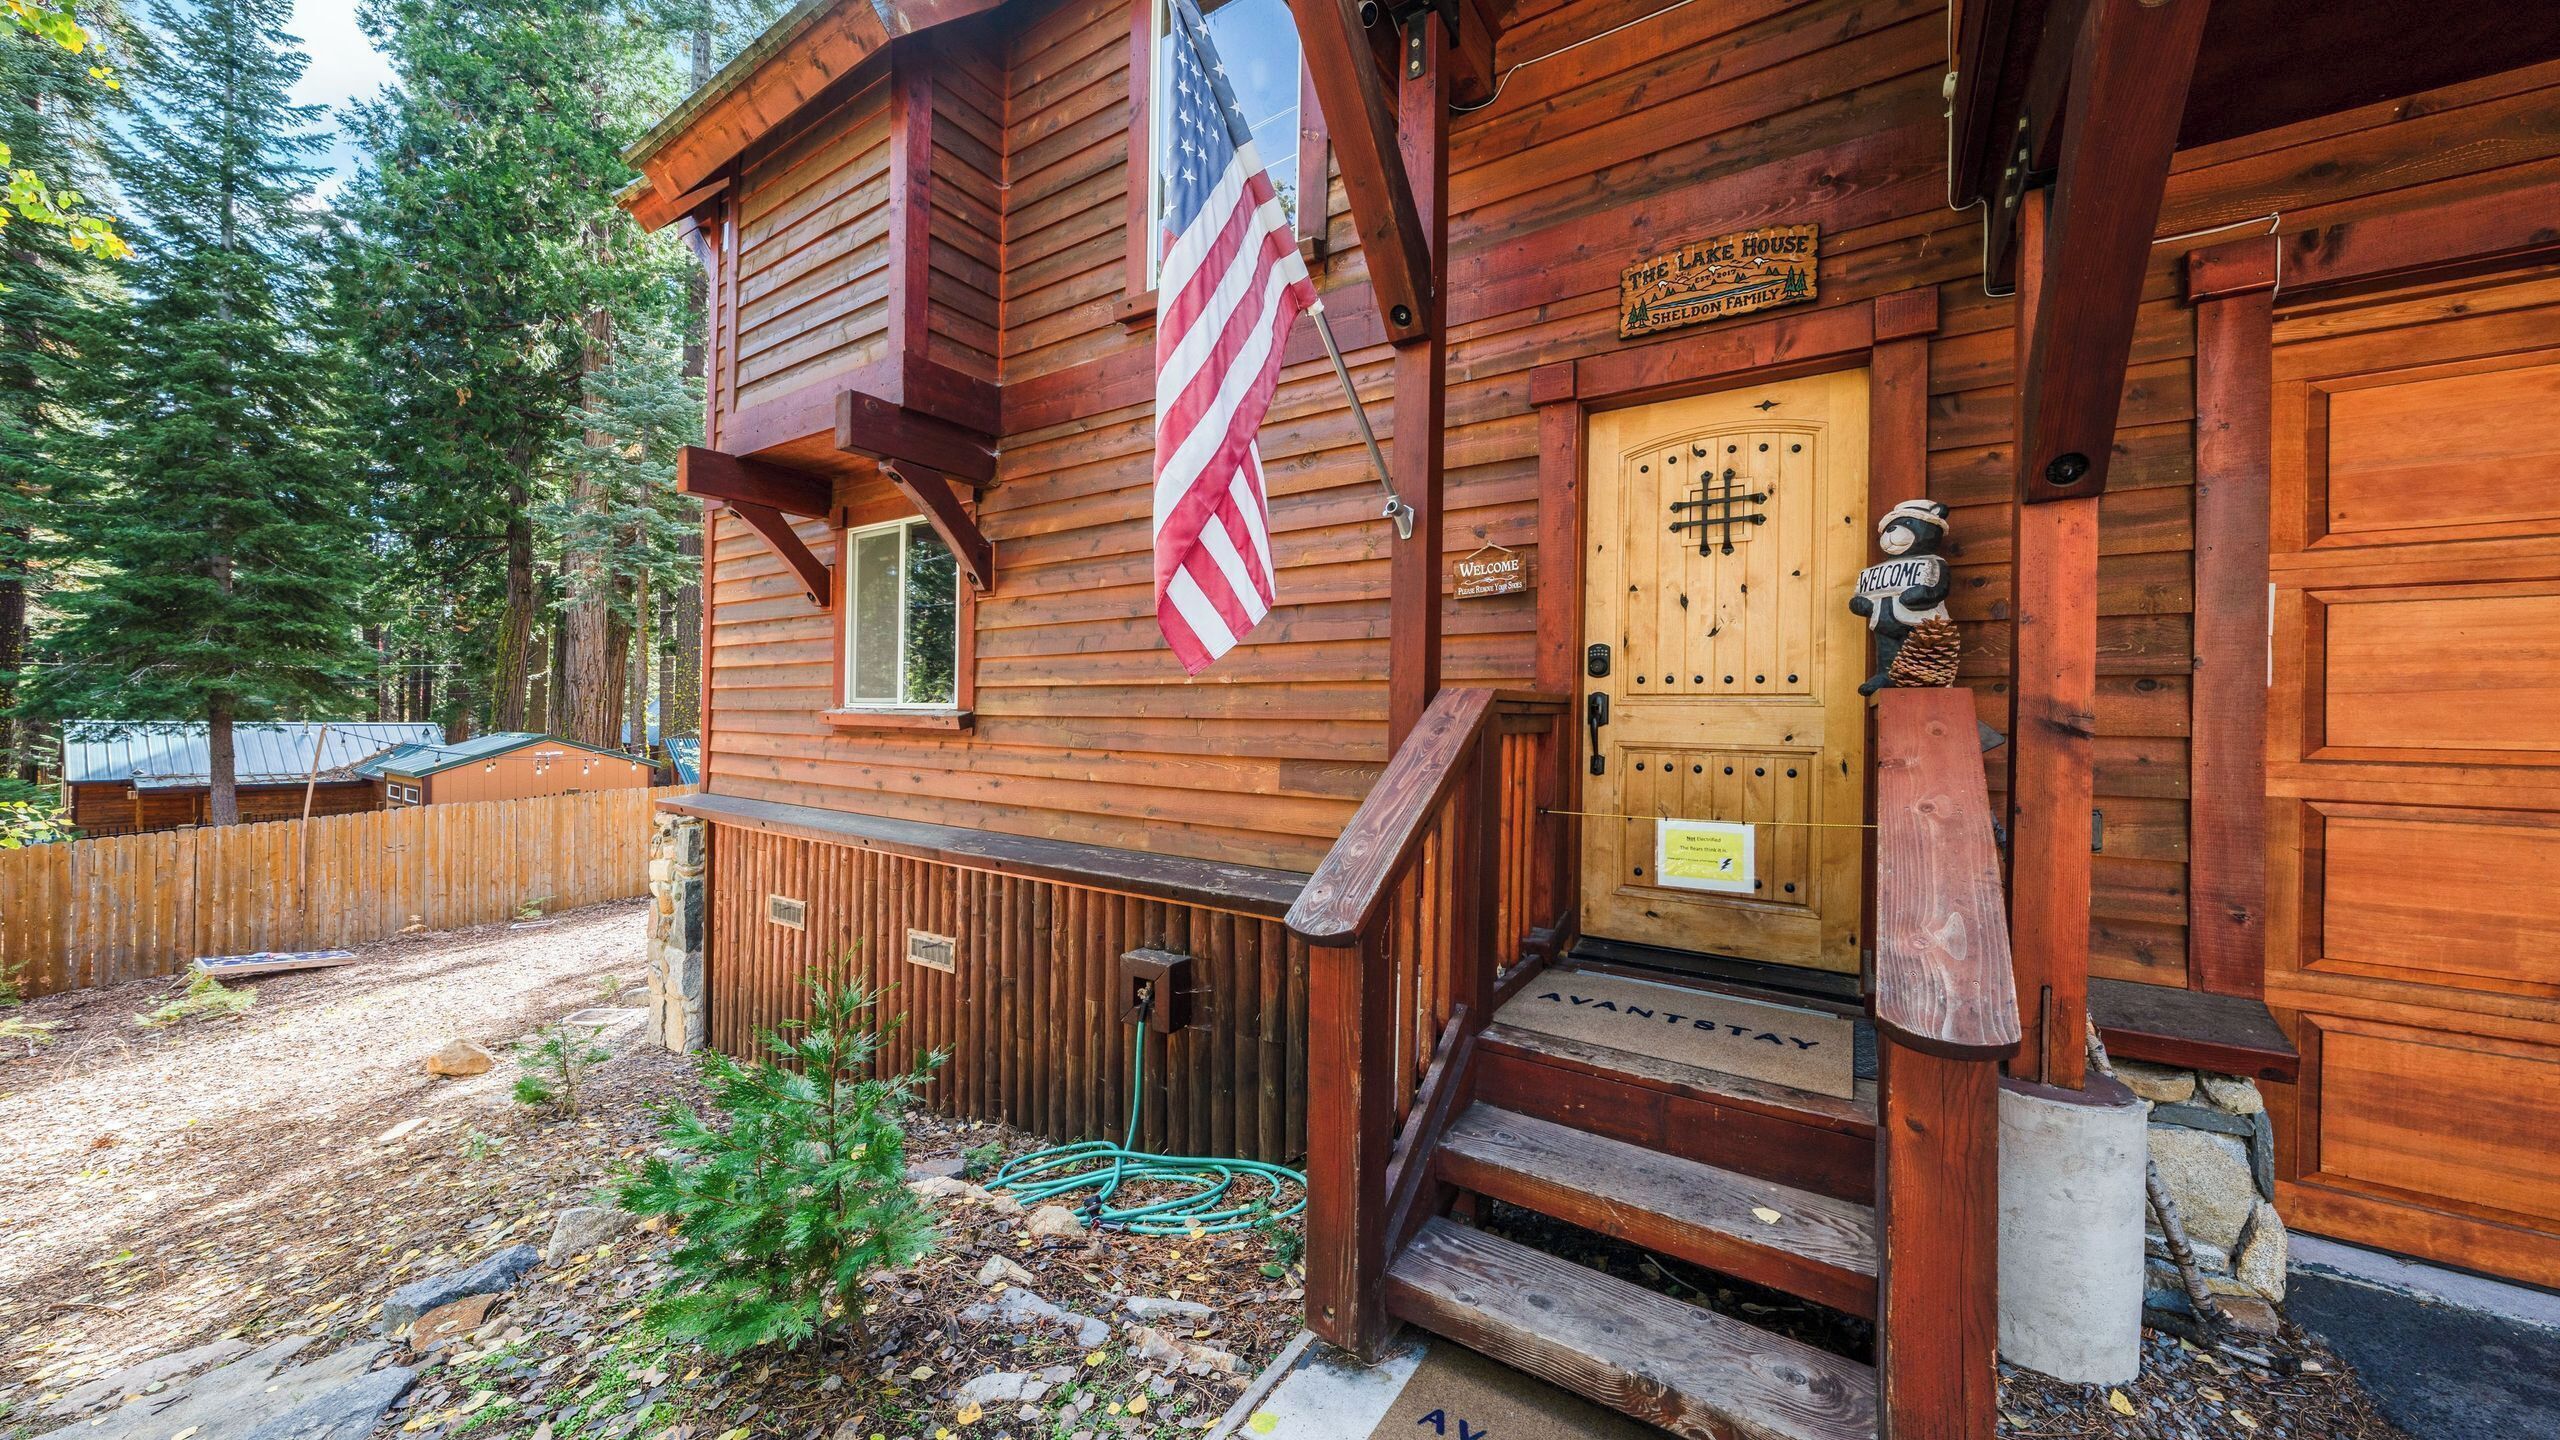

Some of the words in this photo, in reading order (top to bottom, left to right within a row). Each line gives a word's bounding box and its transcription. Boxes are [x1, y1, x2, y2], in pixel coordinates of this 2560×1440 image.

[1628, 262, 1669, 290] THE
[1677, 244, 1735, 270] LAKE
[1741, 235, 1810, 258] HOUSE
[1695, 274, 1712, 284] EST.
[1716, 269, 1737, 279] 2017
[1651, 300, 1723, 325] SHELDON
[1725, 287, 1781, 311] FAMILY
[1459, 559, 1520, 578] WELCOME
[1859, 562, 1926, 594] WELCOME
[1458, 587, 1475, 596] PLEASE
[1537, 992, 1820, 1050] AVANTSTAY
